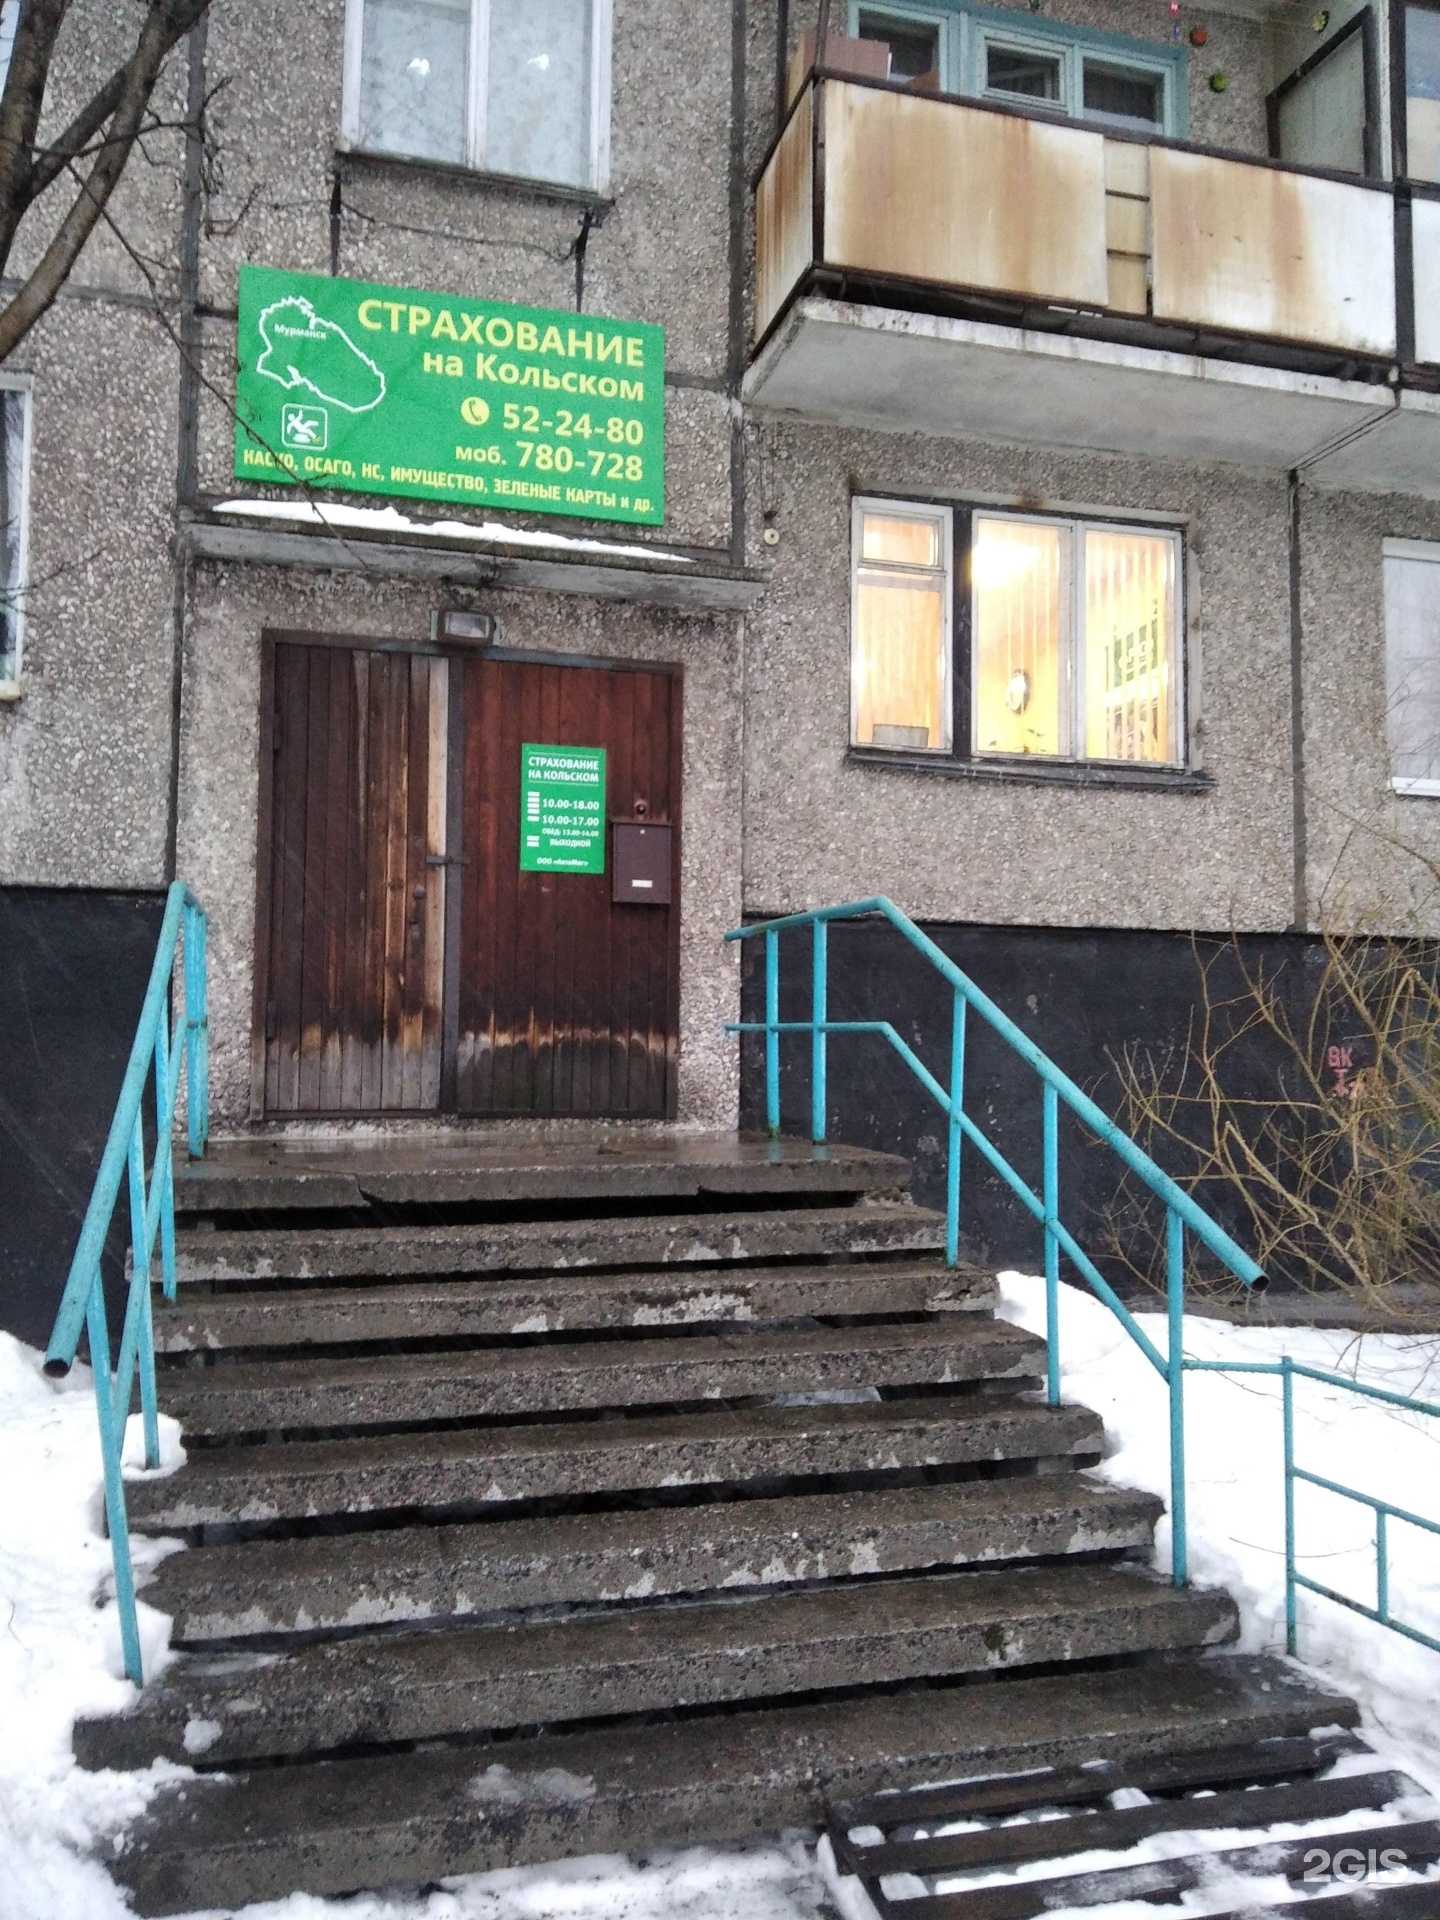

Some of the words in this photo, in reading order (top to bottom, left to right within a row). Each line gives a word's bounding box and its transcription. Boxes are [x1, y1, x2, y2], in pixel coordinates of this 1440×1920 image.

[274, 323, 327, 338] Мурманск
[358, 299, 644, 367] СТРАХОВАНИЕ
[423, 352, 464, 377] на
[476, 353, 644, 401] Кольском
[503, 402, 644, 445] 52-24-80
[455, 446, 507, 466] моб.
[516, 441, 644, 481] 780-728
[304, 456, 356, 479] ОСАГО,
[362, 463, 385, 481] НС,
[391, 465, 488, 494] ИМУЩЕСТВО,
[493, 478, 561, 500] ЗЕЛЕНЫЕ
[566, 487, 616, 508] КАРТЫ
[621, 496, 630, 508] и
[633, 498, 655, 513] др.
[528, 756, 600, 771] СТРАХОВАНИЕ
[528, 769, 543, 779] НА
[543, 770, 600, 783] КОЛЬСКОМ
[542, 798, 600, 811] 10.00-18.00
[542, 814, 600, 827] 10.00-17.00
